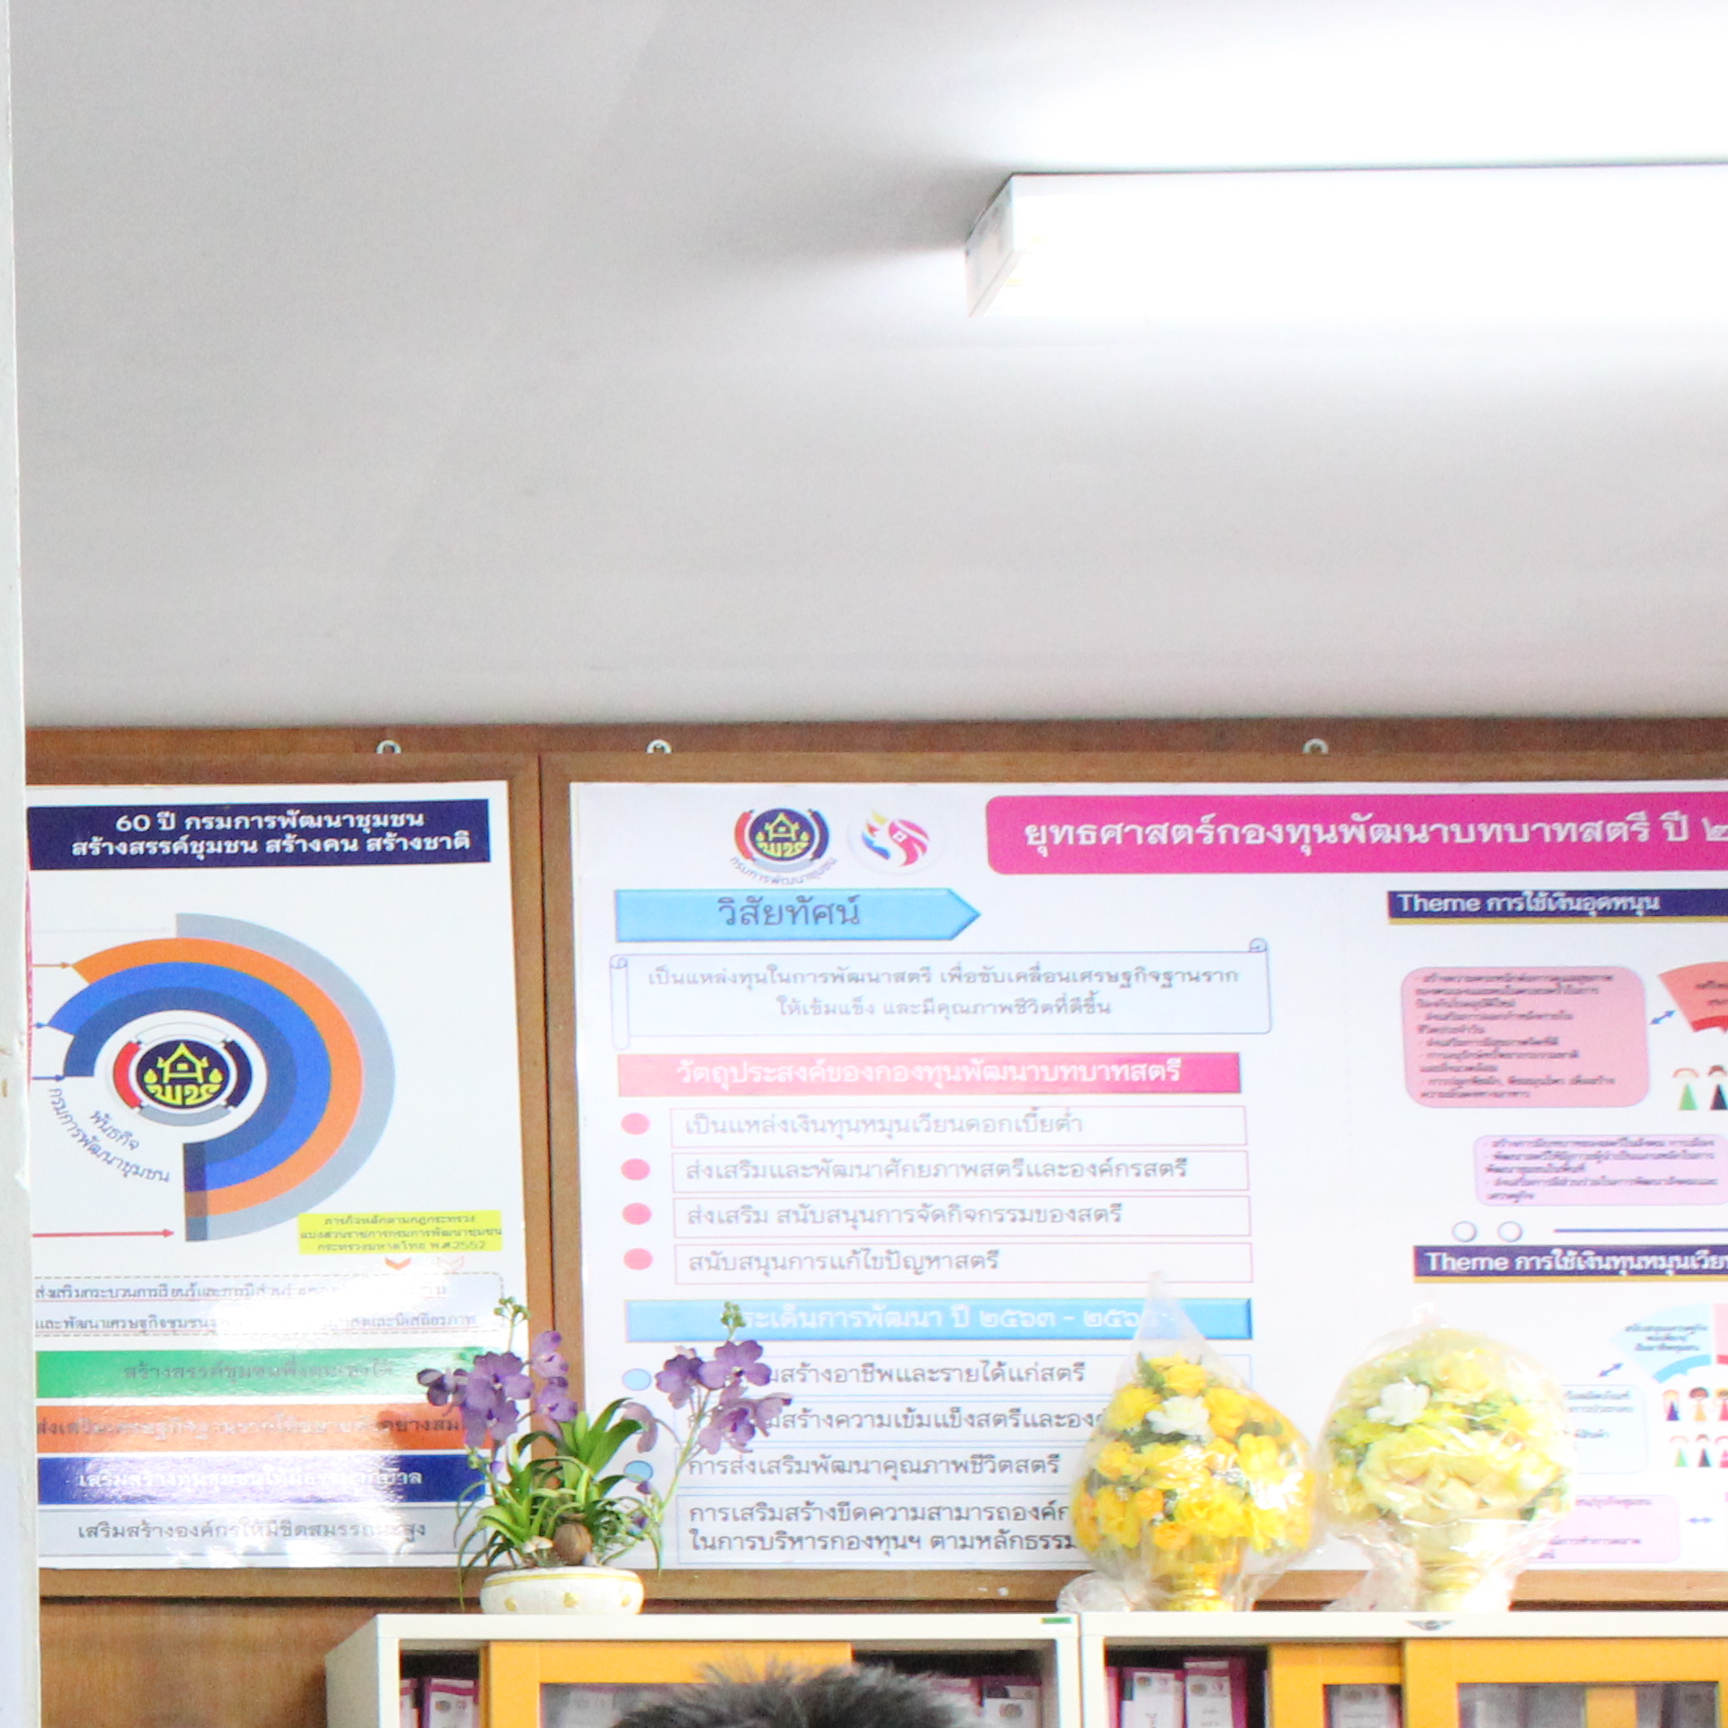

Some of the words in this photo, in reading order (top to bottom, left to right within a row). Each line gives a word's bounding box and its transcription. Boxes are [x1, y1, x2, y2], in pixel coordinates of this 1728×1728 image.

[115, 814, 151, 832] 60
[157, 808, 179, 833] ปี
[184, 808, 425, 836] กรมการพัฒนาชุมชน
[1024, 810, 1650, 858] ยุทธศาสตร์กองทุนพัฒนาบทบาทสตรี
[1657, 809, 1691, 843] ปี
[71, 834, 259, 861] สร้างสรรค์ชุมชน
[265, 833, 359, 854] สร้างคน
[364, 828, 471, 852] สร้างชาติ
[716, 893, 861, 927] วิสัยทัศน์
[1397, 892, 1483, 914] Theme
[648, 963, 933, 991] เป็นแหล่งทุนในการพัฒนาสตรี
[674, 1055, 1183, 1091] วัตถุประสงค์ของกองทุนพัฒนาบทบาทสตรี
[687, 1203, 769, 1225] ส่งเสริม
[688, 1247, 1001, 1278] สนับสนุนการแก้ไขปัญหาสตรี
[1423, 1250, 1510, 1274] Theme
[745, 1302, 946, 1331] ระเด็นการพัฒนา
[951, 1303, 972, 1330] ปี
[687, 1451, 1062, 1482] การส่งเสริมพัฒนาคุณภาพชีวิตสตรี
